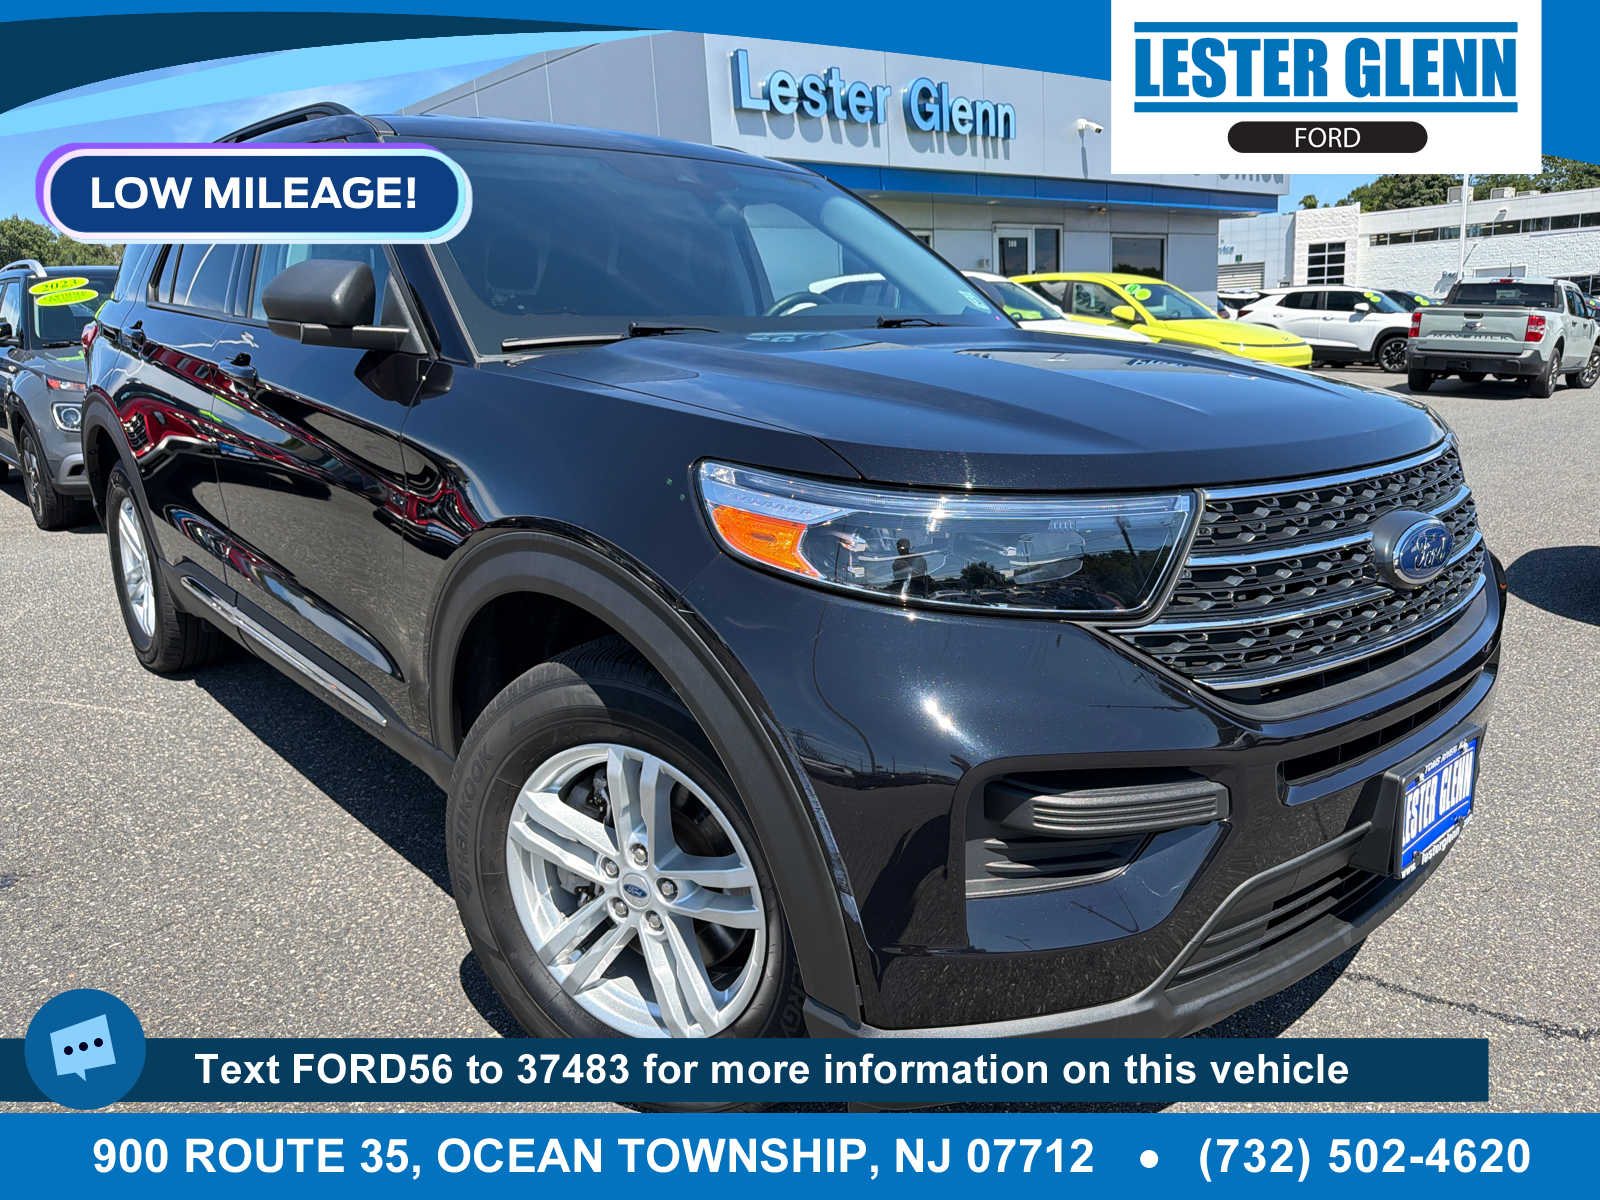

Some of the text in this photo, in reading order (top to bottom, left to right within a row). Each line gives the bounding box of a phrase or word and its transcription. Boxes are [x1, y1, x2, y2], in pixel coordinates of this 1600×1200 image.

[730, 48, 1016, 140] Lester Glenn
[1409, 530, 1447, 572] Ford
[1439, 751, 1474, 816] GLENN
